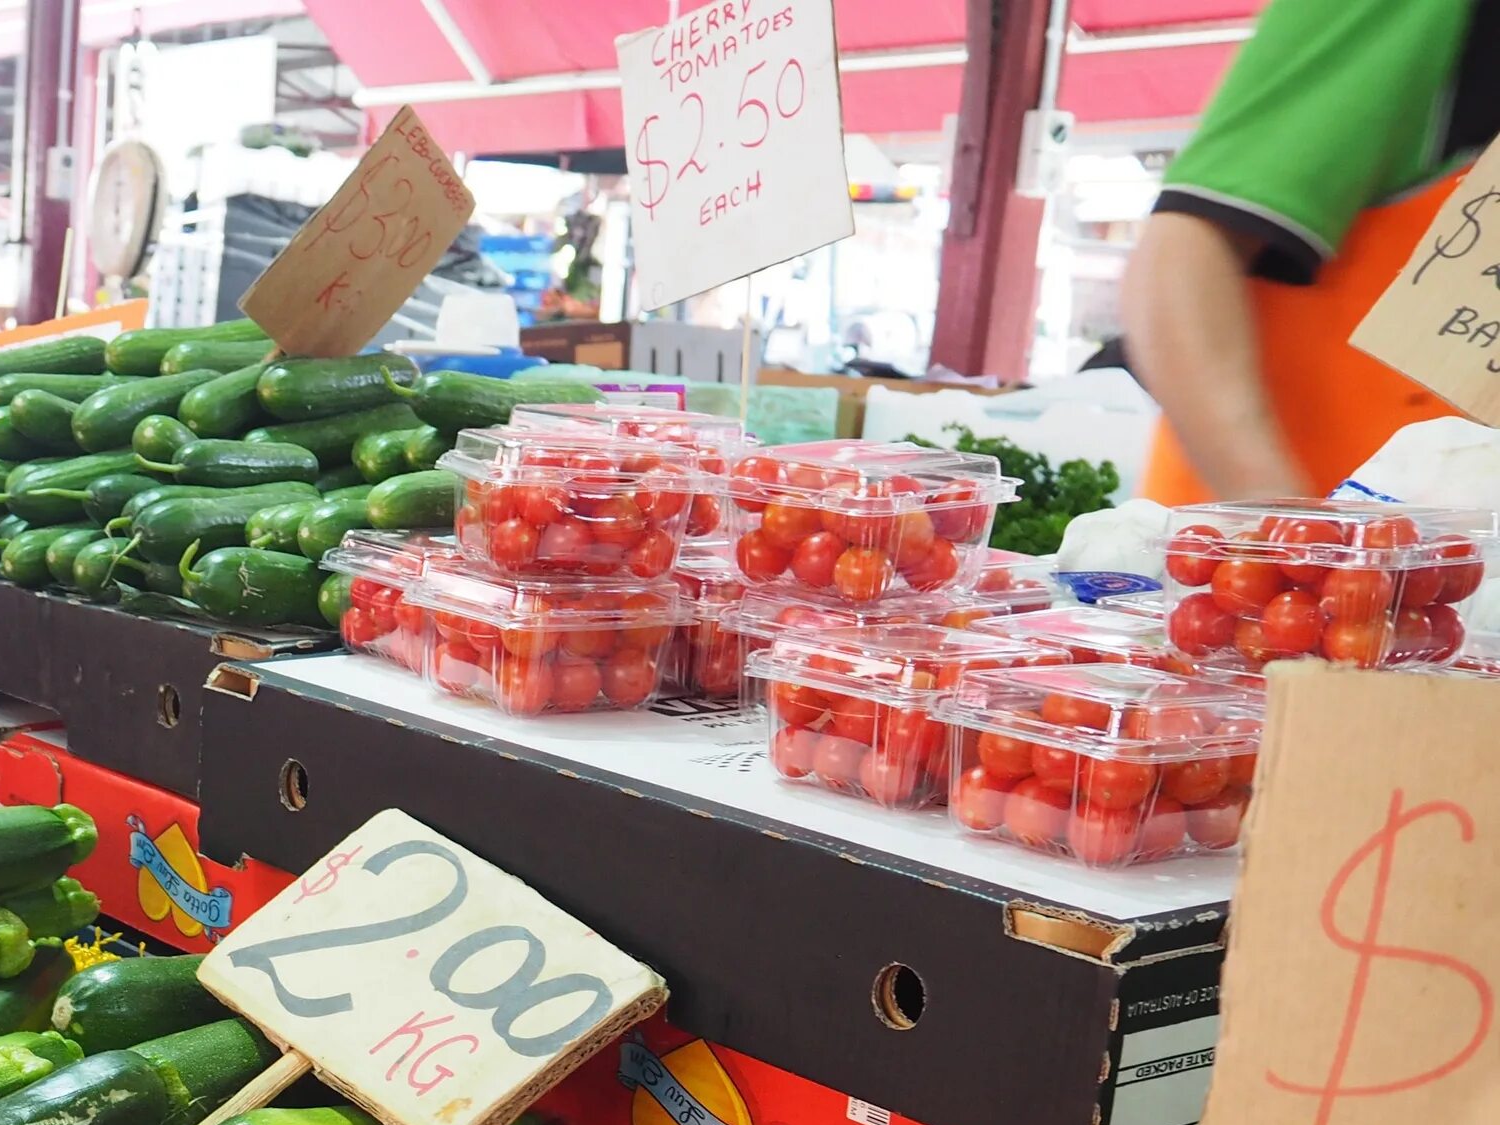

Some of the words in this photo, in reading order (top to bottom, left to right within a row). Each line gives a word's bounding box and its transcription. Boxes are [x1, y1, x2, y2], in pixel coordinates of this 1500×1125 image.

[652, 0, 751, 66] CHERRY
[660, 7, 793, 92] TOMATOES
[636, 58, 805, 221] $2.50
[700, 170, 762, 225] EACH
[1127, 994, 1182, 1018] AUSTRALIA
[368, 1010, 480, 1097] KG
[1136, 1057, 1183, 1078] PACKED
